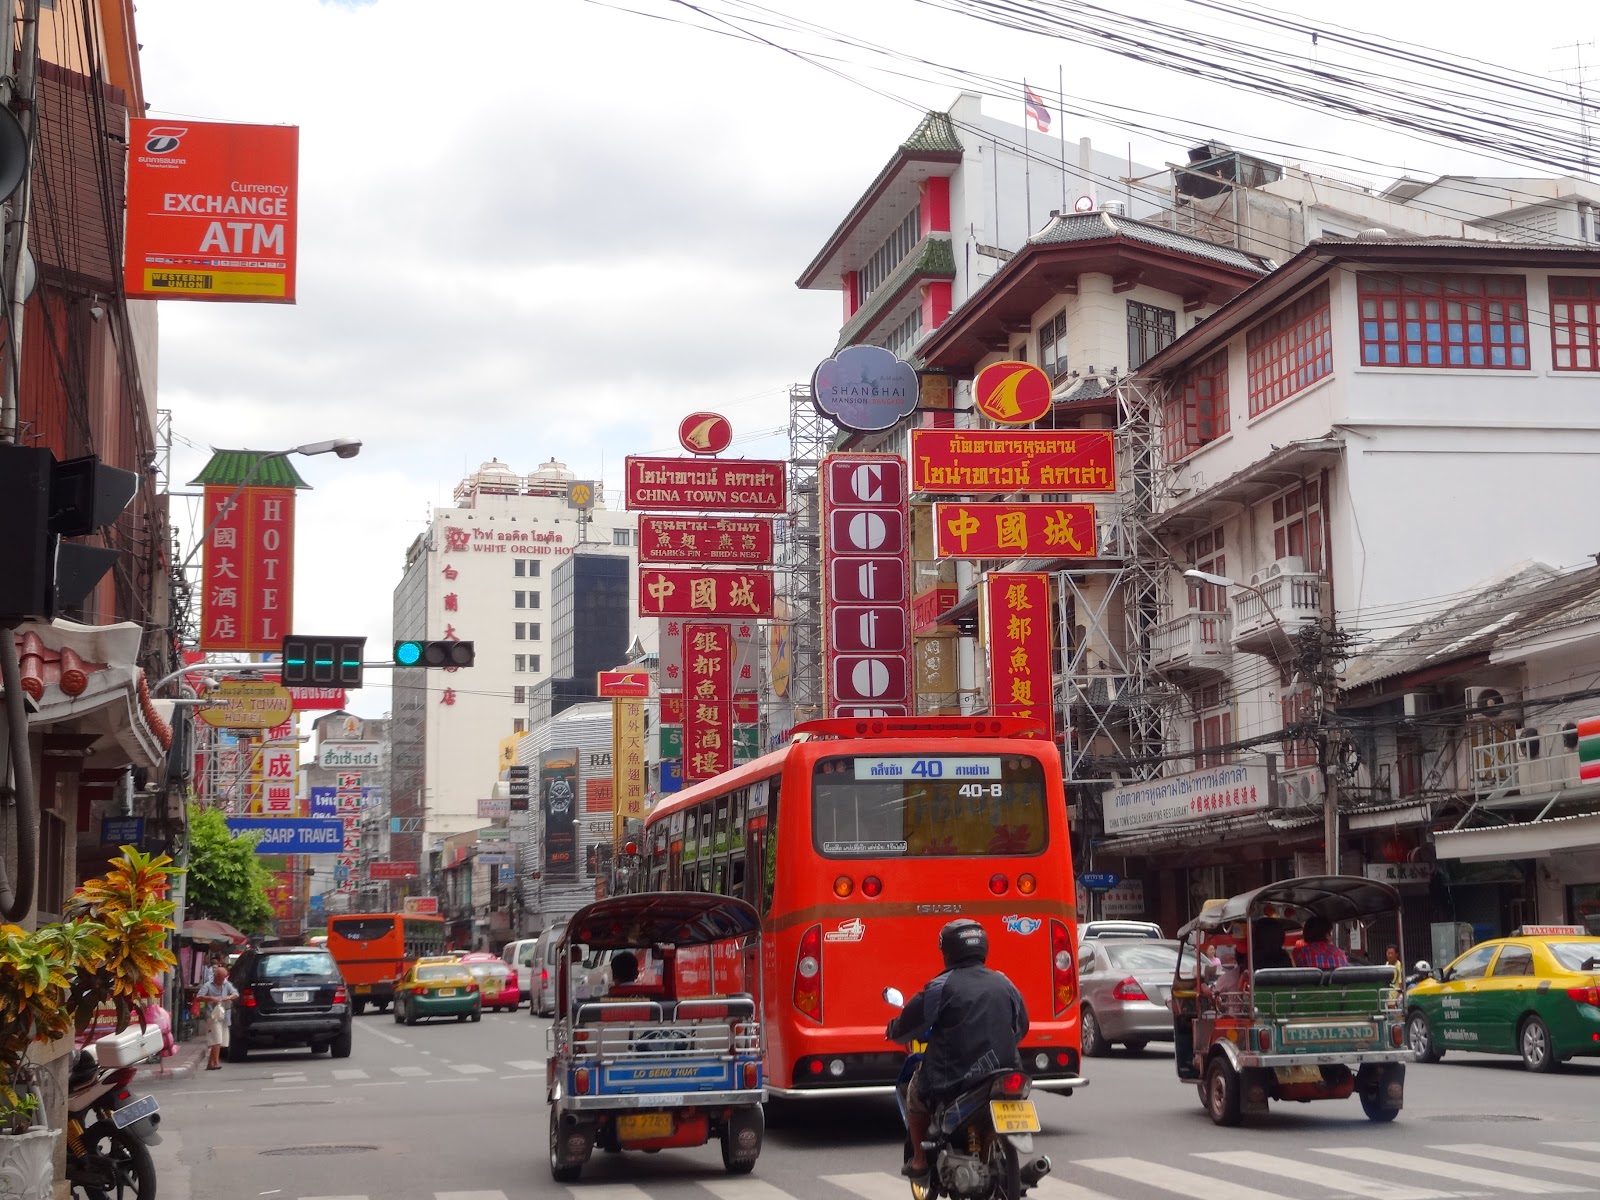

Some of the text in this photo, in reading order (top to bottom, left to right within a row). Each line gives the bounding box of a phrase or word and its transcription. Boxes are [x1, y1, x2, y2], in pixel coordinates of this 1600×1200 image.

[231, 181, 289, 196] Currency
[163, 193, 288, 216] EXCHANGE
[199, 221, 284, 255] ATM
[152, 273, 203, 282] WESTERN
[167, 280, 203, 289] UNION
[831, 386, 905, 397] SHANGHAI
[920, 455, 1107, 485] ไชน่าทาวน์ สกาล่า
[636, 488, 777, 504] CHINA TOWN SCALA
[947, 508, 1081, 553] 中國城
[473, 544, 507, 553] WHITE
[511, 545, 552, 555] ORCHID
[650, 549, 685, 557] SHARK'S
[211, 496, 239, 639] 中國大酒店
[263, 500, 283, 640] HOTEL
[648, 573, 760, 613] 中國城
[250, 698, 288, 711] TOWN
[691, 631, 724, 775] 銀都魚翅酒樓
[224, 713, 266, 723] HOTEL
[911, 760, 943, 777] 40
[959, 783, 1003, 797] 40-8
[298, 828, 340, 843] TRAVEL
[1108, 874, 1114, 883] 2
[916, 904, 962, 913] ISUZU
[1288, 1026, 1374, 1040] THAILAND
[633, 1069, 646, 1079] LO
[675, 1067, 699, 1077] HUAT
